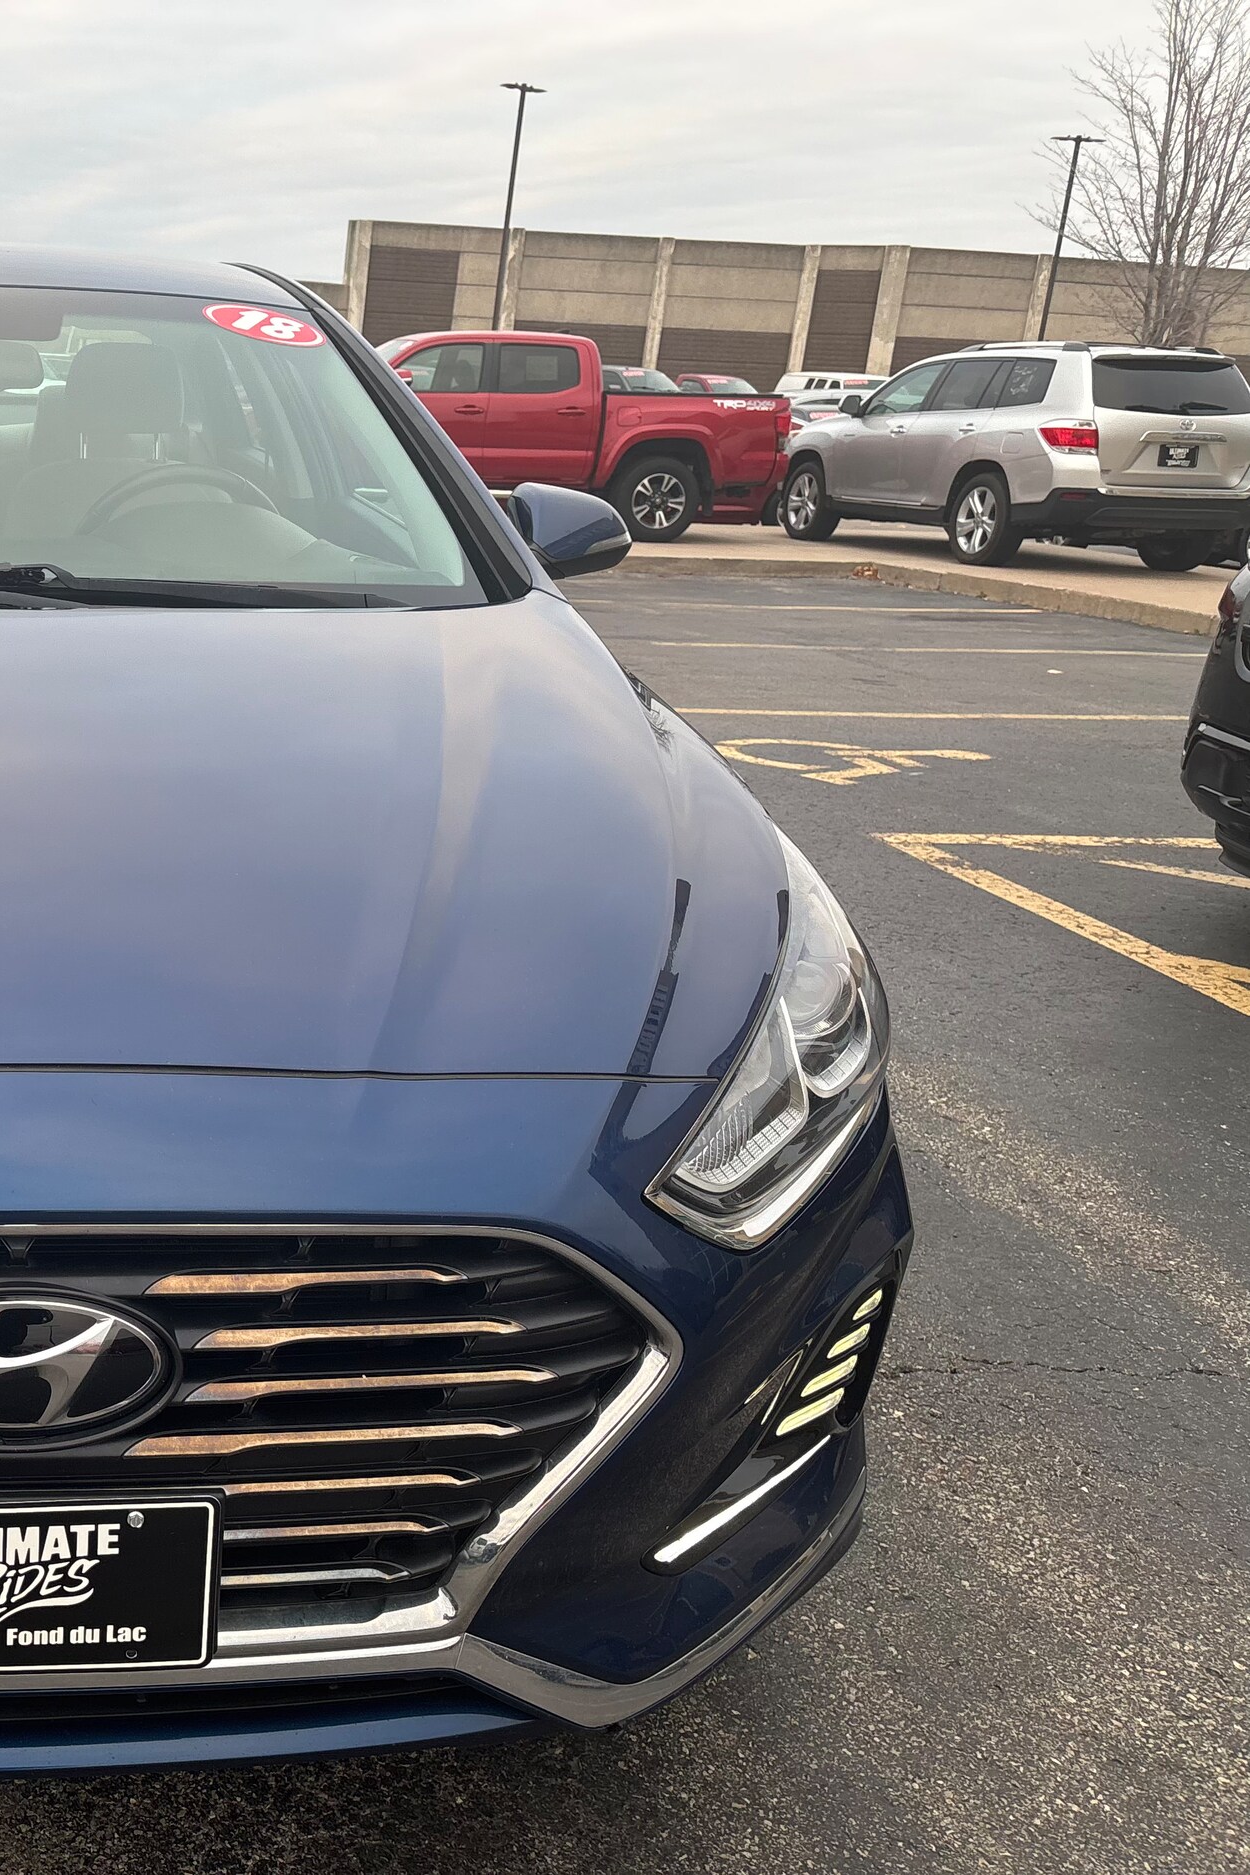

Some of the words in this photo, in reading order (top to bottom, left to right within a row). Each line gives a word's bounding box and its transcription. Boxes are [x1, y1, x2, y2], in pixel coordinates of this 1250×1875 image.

[231, 310, 305, 340] 18
[713, 399, 746, 409] TRD
[6, 1626, 64, 1646] Fond
[70, 1625, 100, 1645] du
[106, 1624, 147, 1643] Lac
